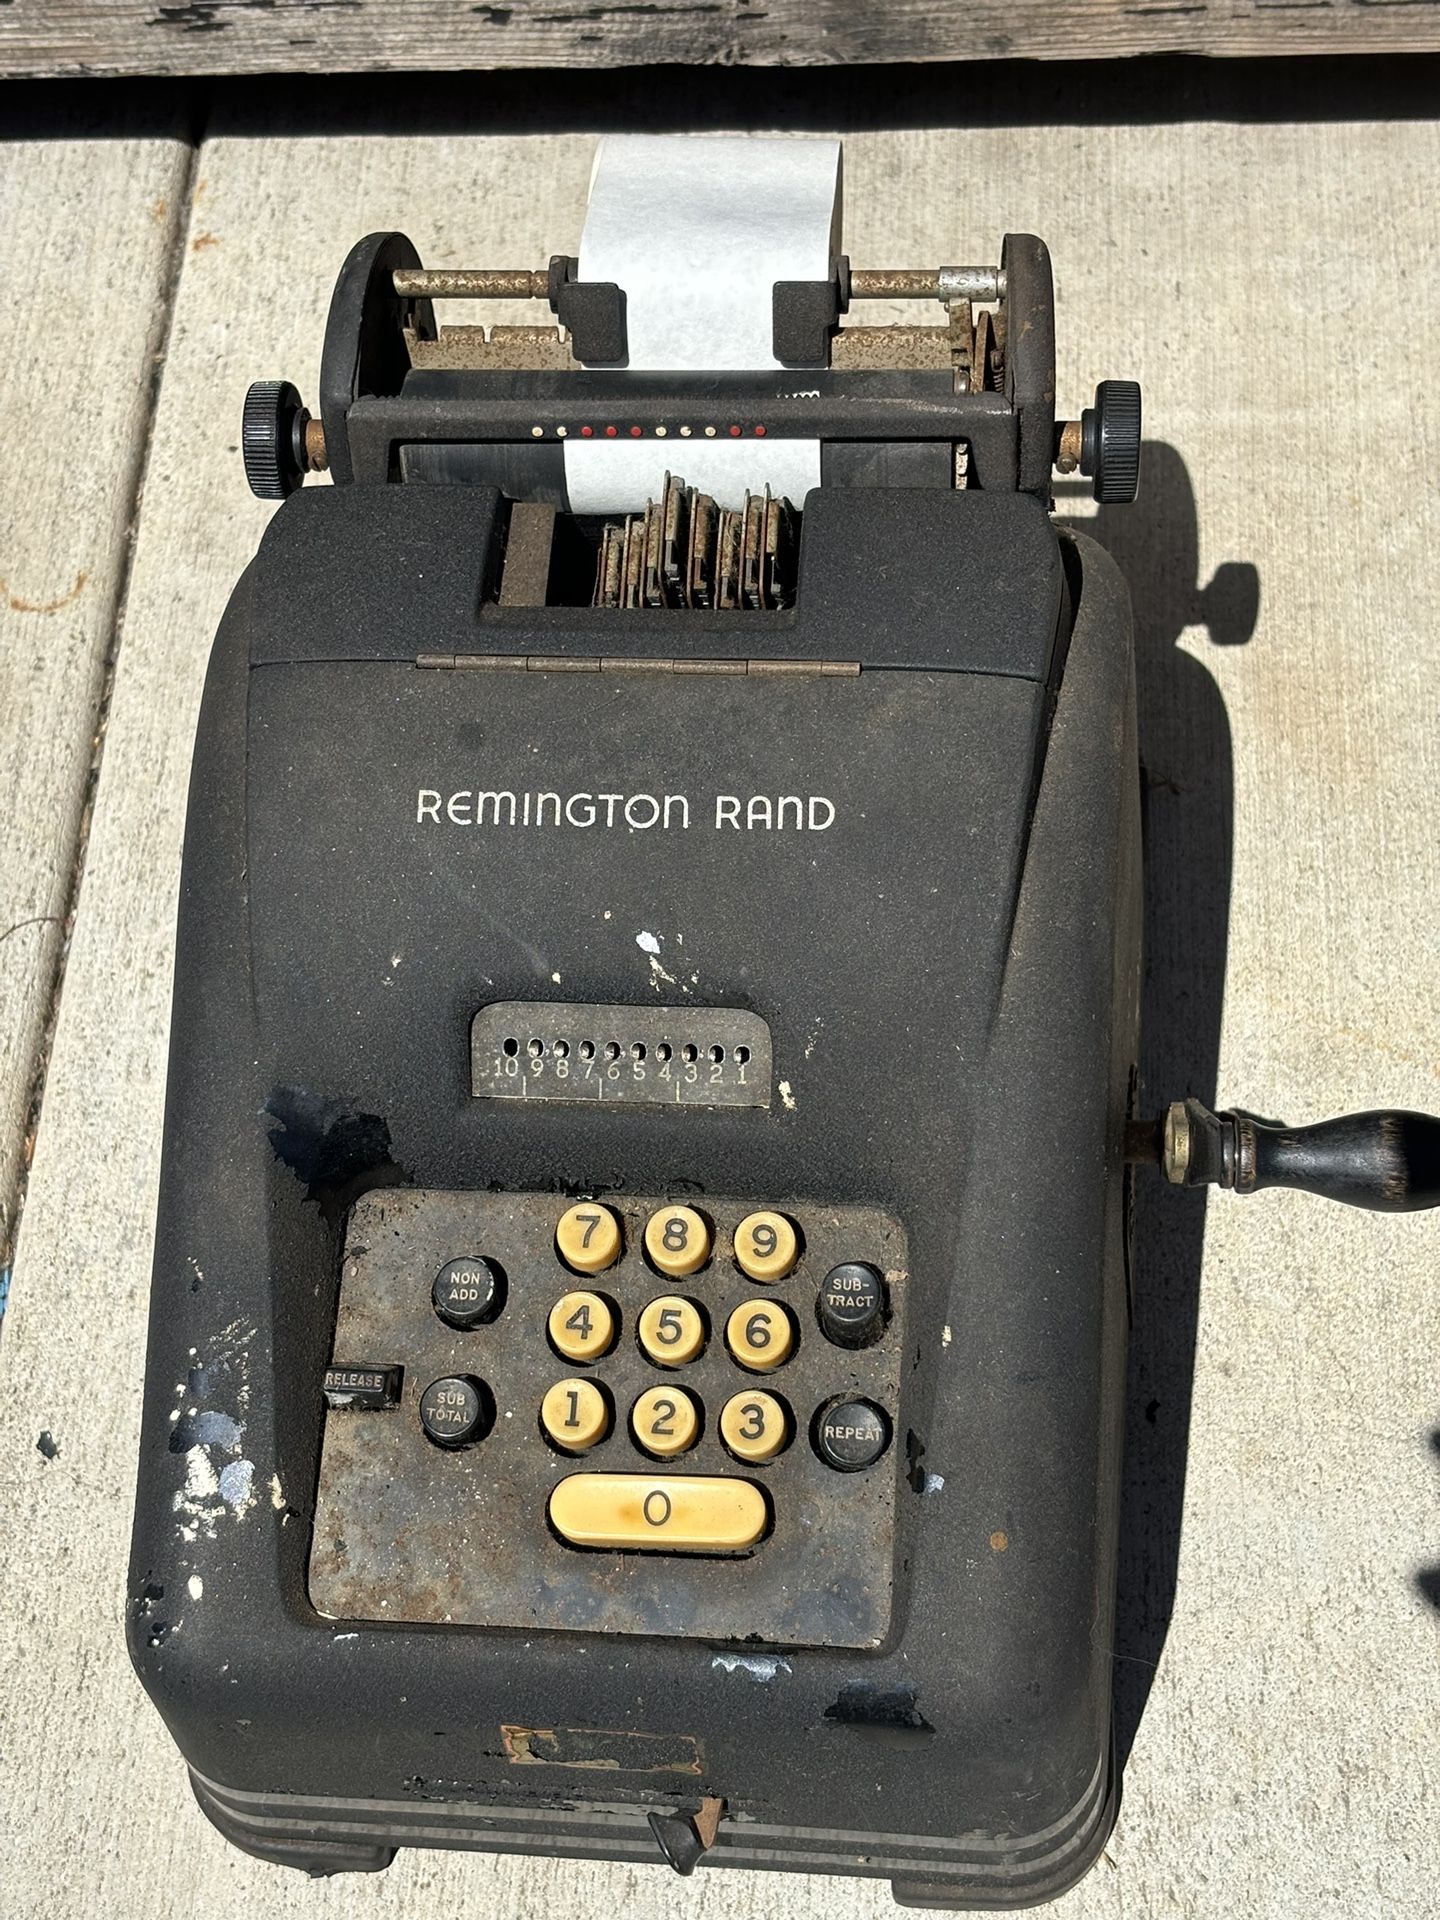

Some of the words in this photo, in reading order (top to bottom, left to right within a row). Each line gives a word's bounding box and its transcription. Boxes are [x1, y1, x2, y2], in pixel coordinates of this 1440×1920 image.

[416, 789, 690, 830] REMINGTON
[715, 795, 836, 831] RAND
[494, 1057, 519, 1077] 10
[530, 1059, 544, 1078] 9
[556, 1059, 570, 1079] 8
[581, 1060, 596, 1080] 7
[606, 1060, 621, 1080] 6
[632, 1061, 646, 1080] 5
[658, 1062, 672, 1082] 4
[684, 1063, 698, 1083] 3
[709, 1064, 724, 1084] 2
[736, 1065, 748, 1085] 1
[575, 1214, 602, 1249] 7
[661, 1217, 690, 1252] 8
[751, 1223, 779, 1258] 9
[449, 1288, 479, 1301] ADD
[450, 1271, 481, 1285] NON
[832, 1277, 870, 1292] SUB-
[826, 1294, 874, 1308] TRACT
[564, 1304, 594, 1340] 4
[655, 1308, 683, 1345] 5
[745, 1313, 772, 1349] 6
[324, 1372, 384, 1388] RELEASE
[426, 1407, 471, 1424] TOTAL
[436, 1391, 466, 1407] SUB
[563, 1390, 581, 1428] 1
[650, 1399, 677, 1436] 2
[738, 1402, 766, 1440] 3
[824, 1425, 883, 1442] REPEAT
[642, 1489, 672, 1527] 0
